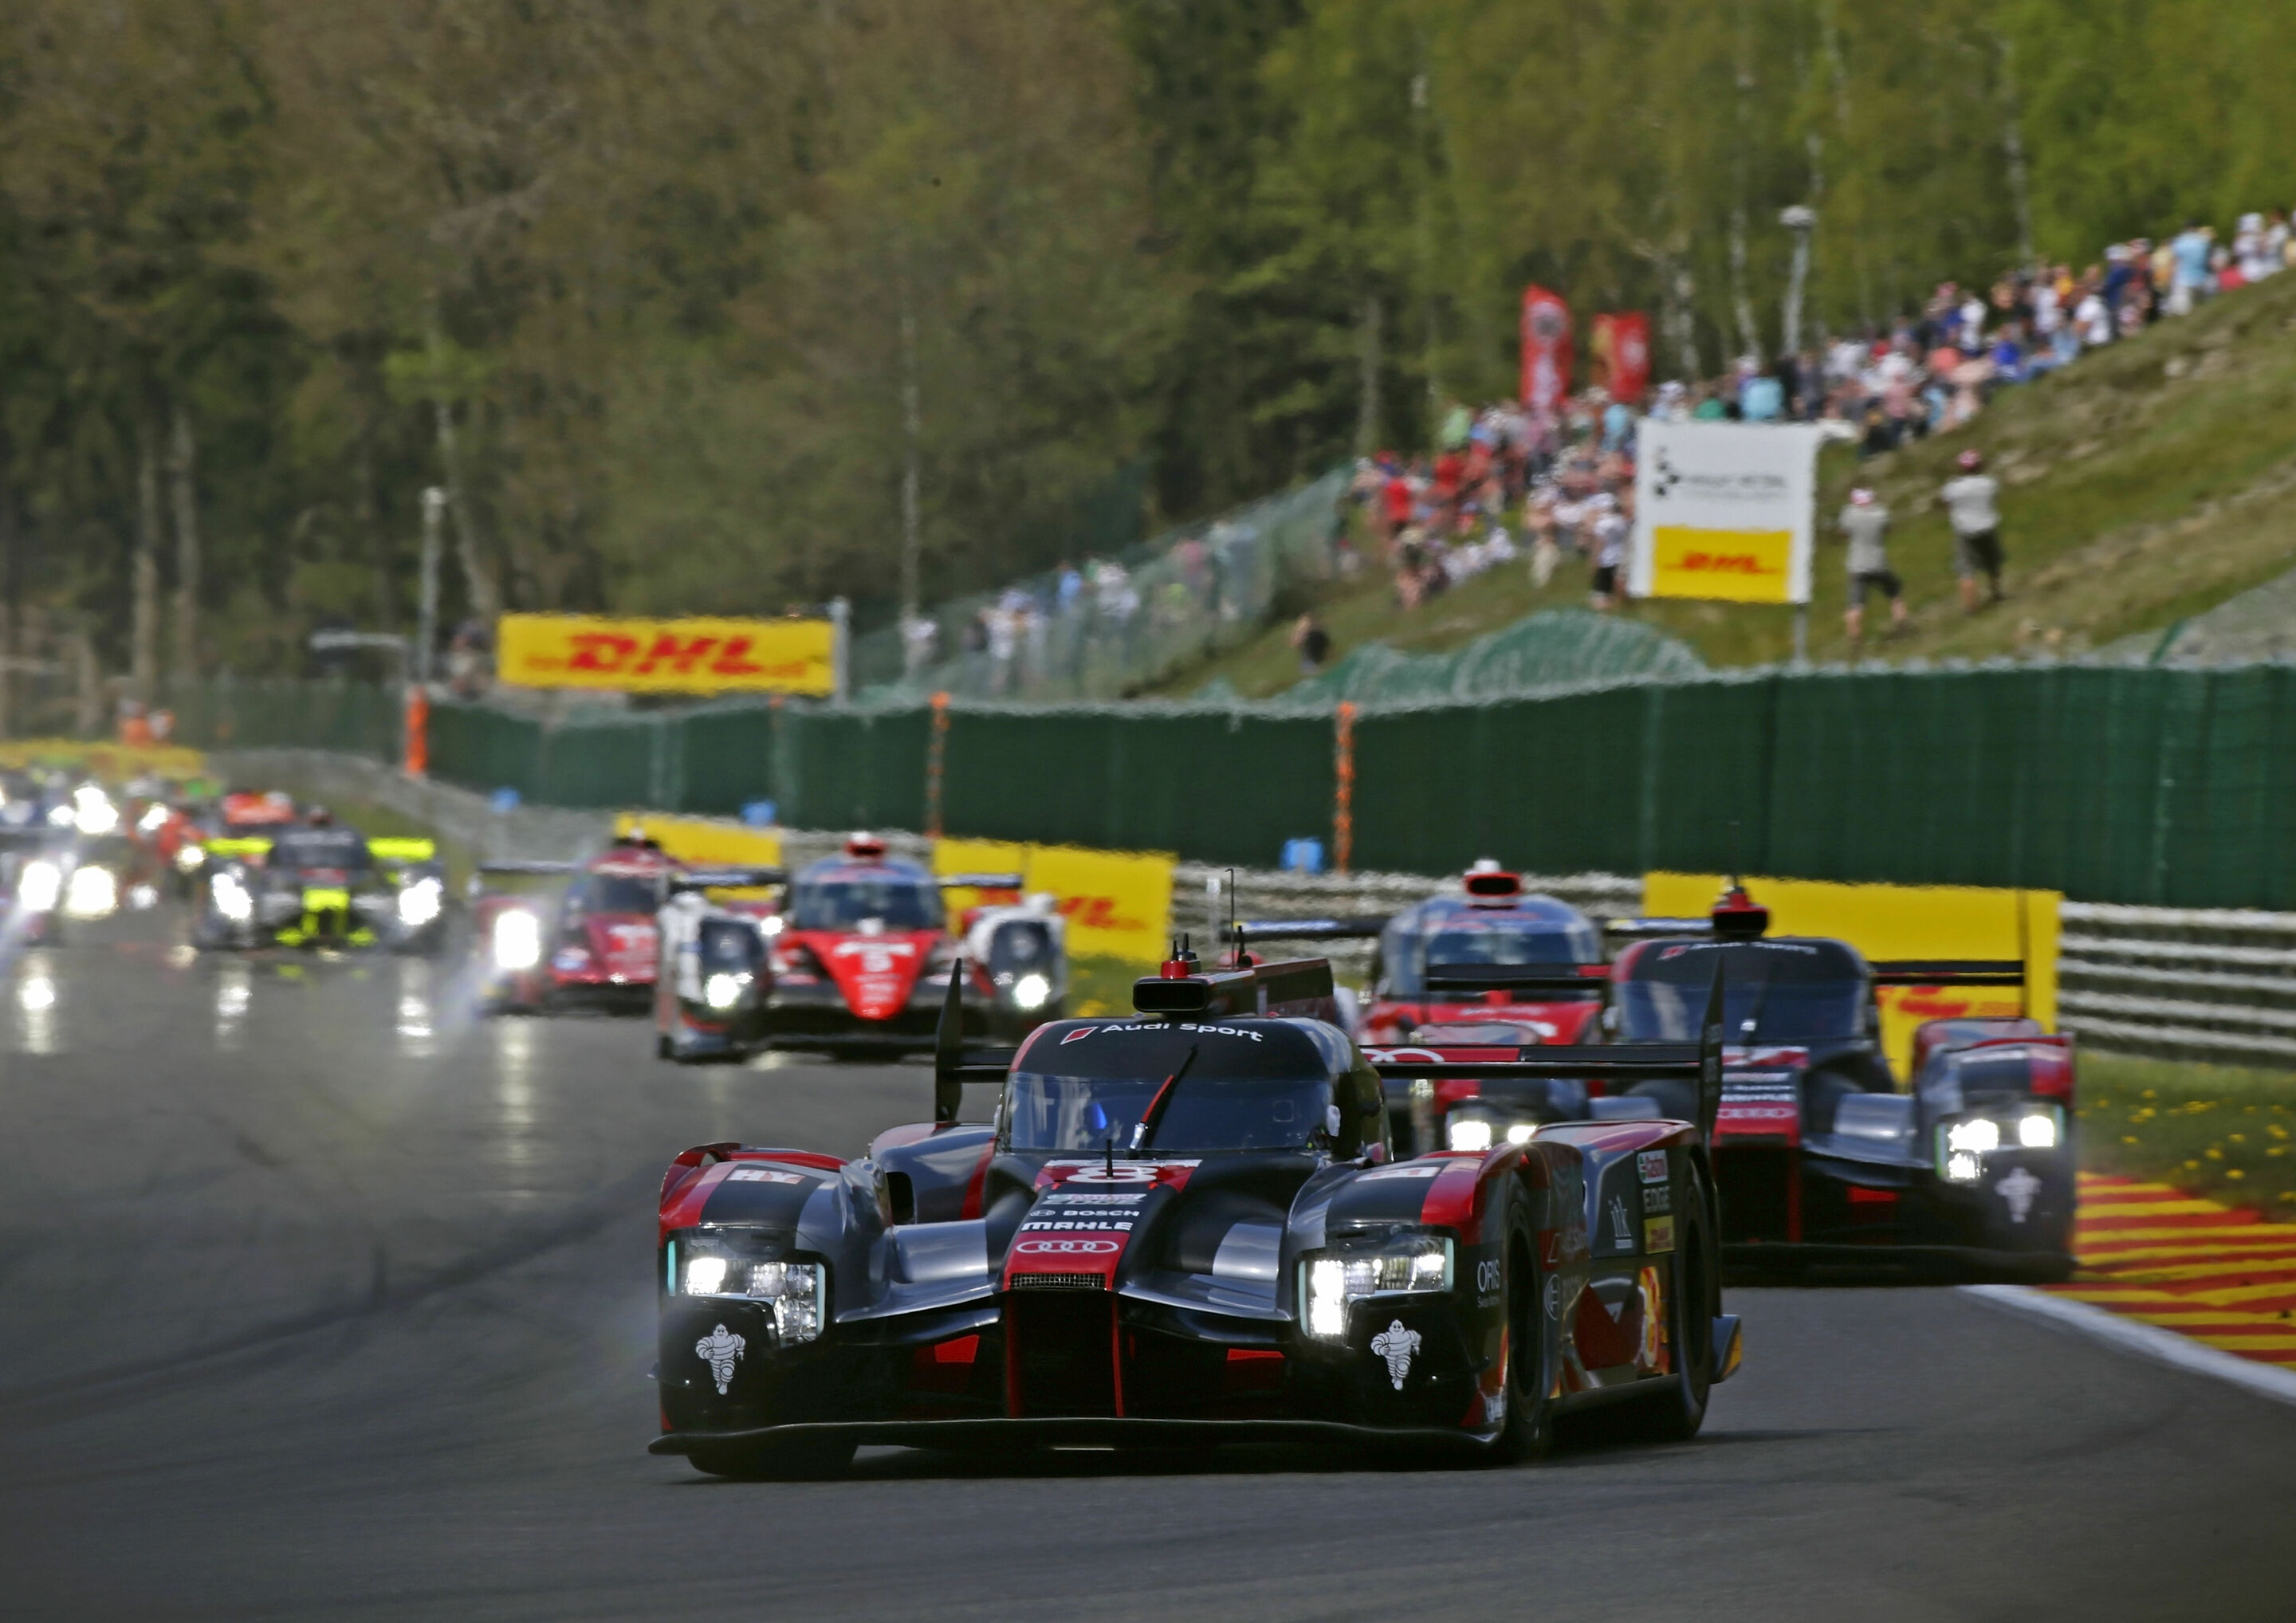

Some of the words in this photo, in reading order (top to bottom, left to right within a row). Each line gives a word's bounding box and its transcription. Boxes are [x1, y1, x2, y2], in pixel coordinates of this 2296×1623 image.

[568, 633, 761, 677] DHL
[1101, 1023, 1170, 1033] Audi
[1179, 1023, 1264, 1043] Sport
[729, 1169, 798, 1184] HY
[1066, 1166, 1158, 1184] 8
[1021, 1221, 1134, 1232] MAHLE
[1477, 1259, 1500, 1293] ORIS
